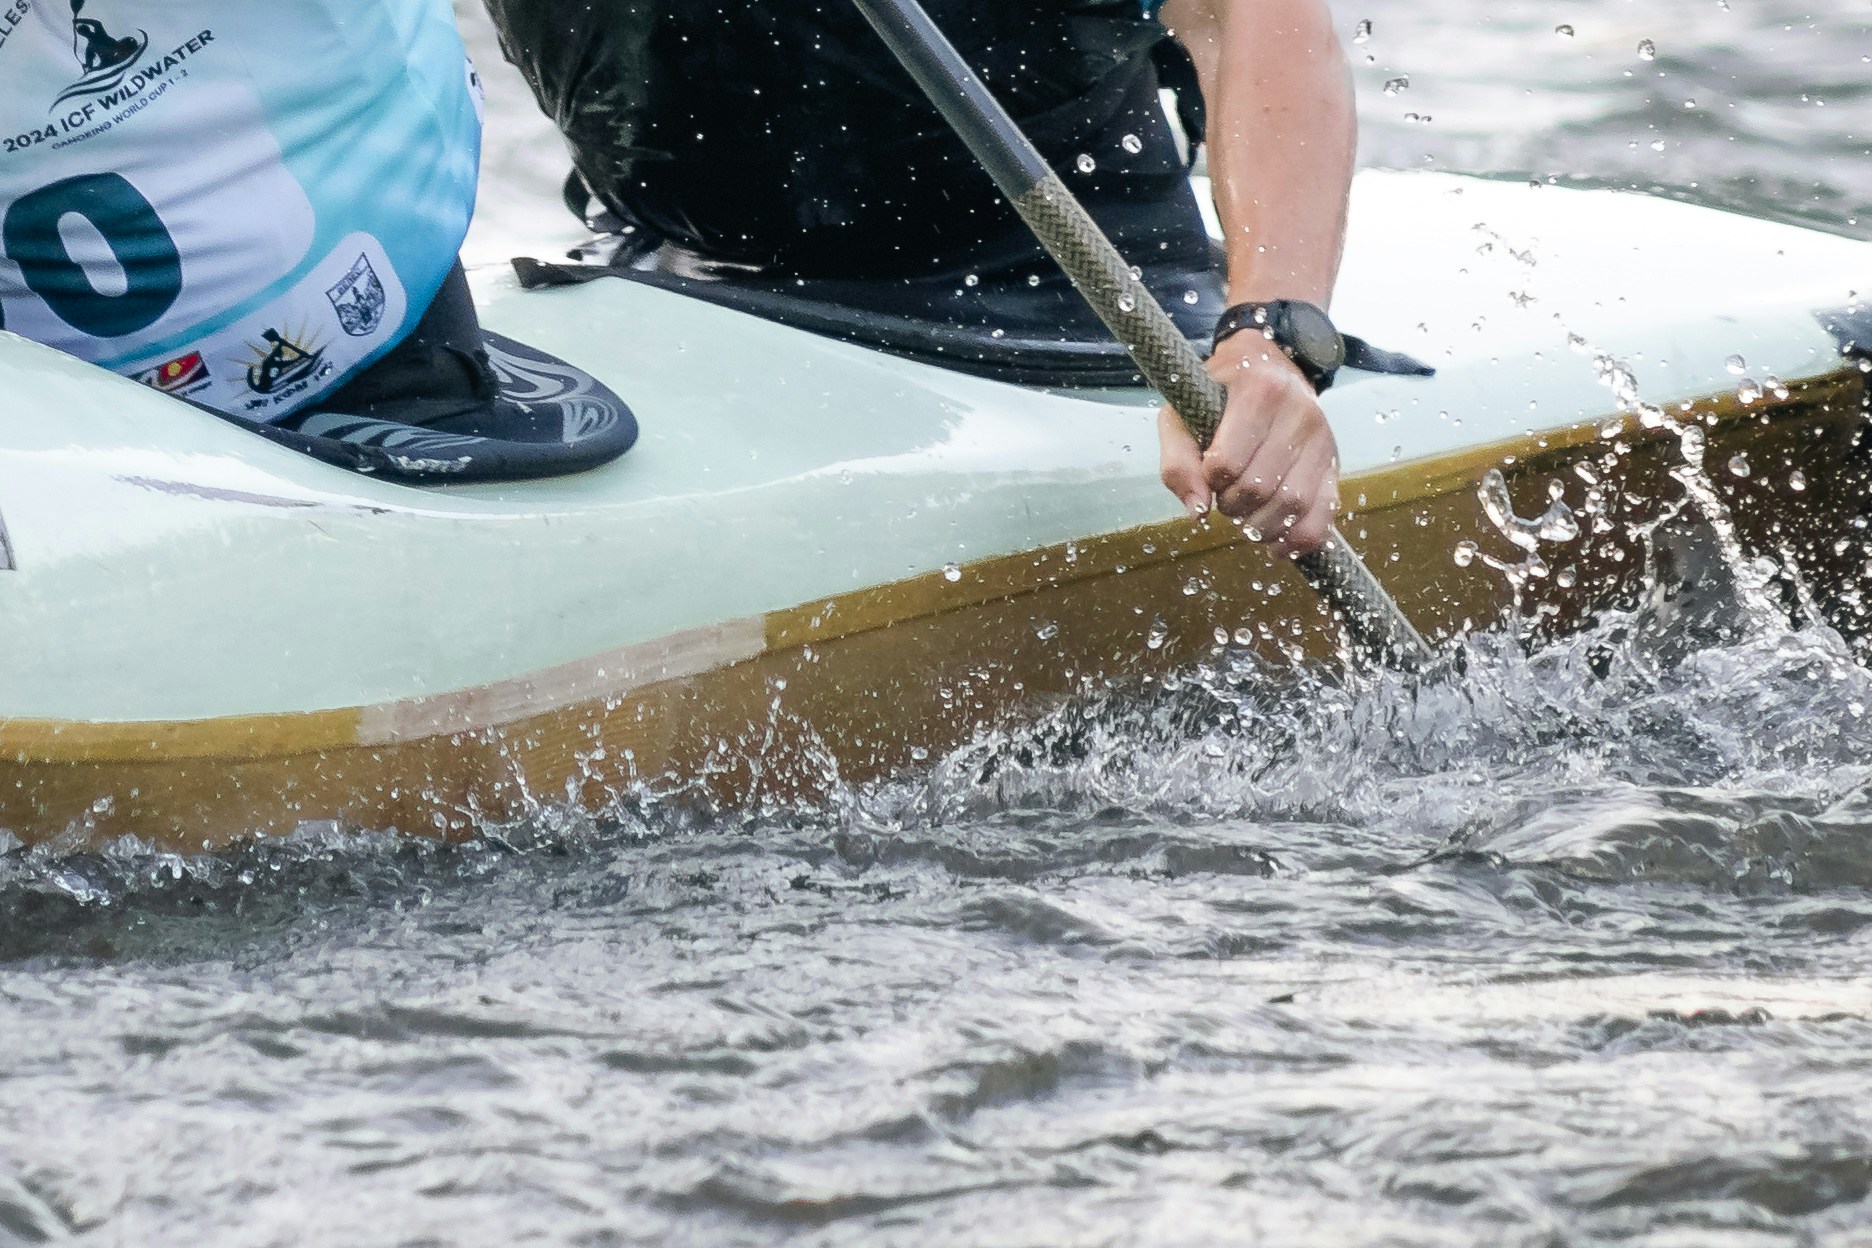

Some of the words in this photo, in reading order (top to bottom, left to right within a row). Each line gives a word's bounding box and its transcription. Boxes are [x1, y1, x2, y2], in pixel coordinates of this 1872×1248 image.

[2, 123, 59, 153] 2024
[60, 102, 96, 133] ICF
[96, 29, 215, 111] WILDWATER
[112, 97, 149, 124] WORLD
[148, 82, 168, 101] CUP
